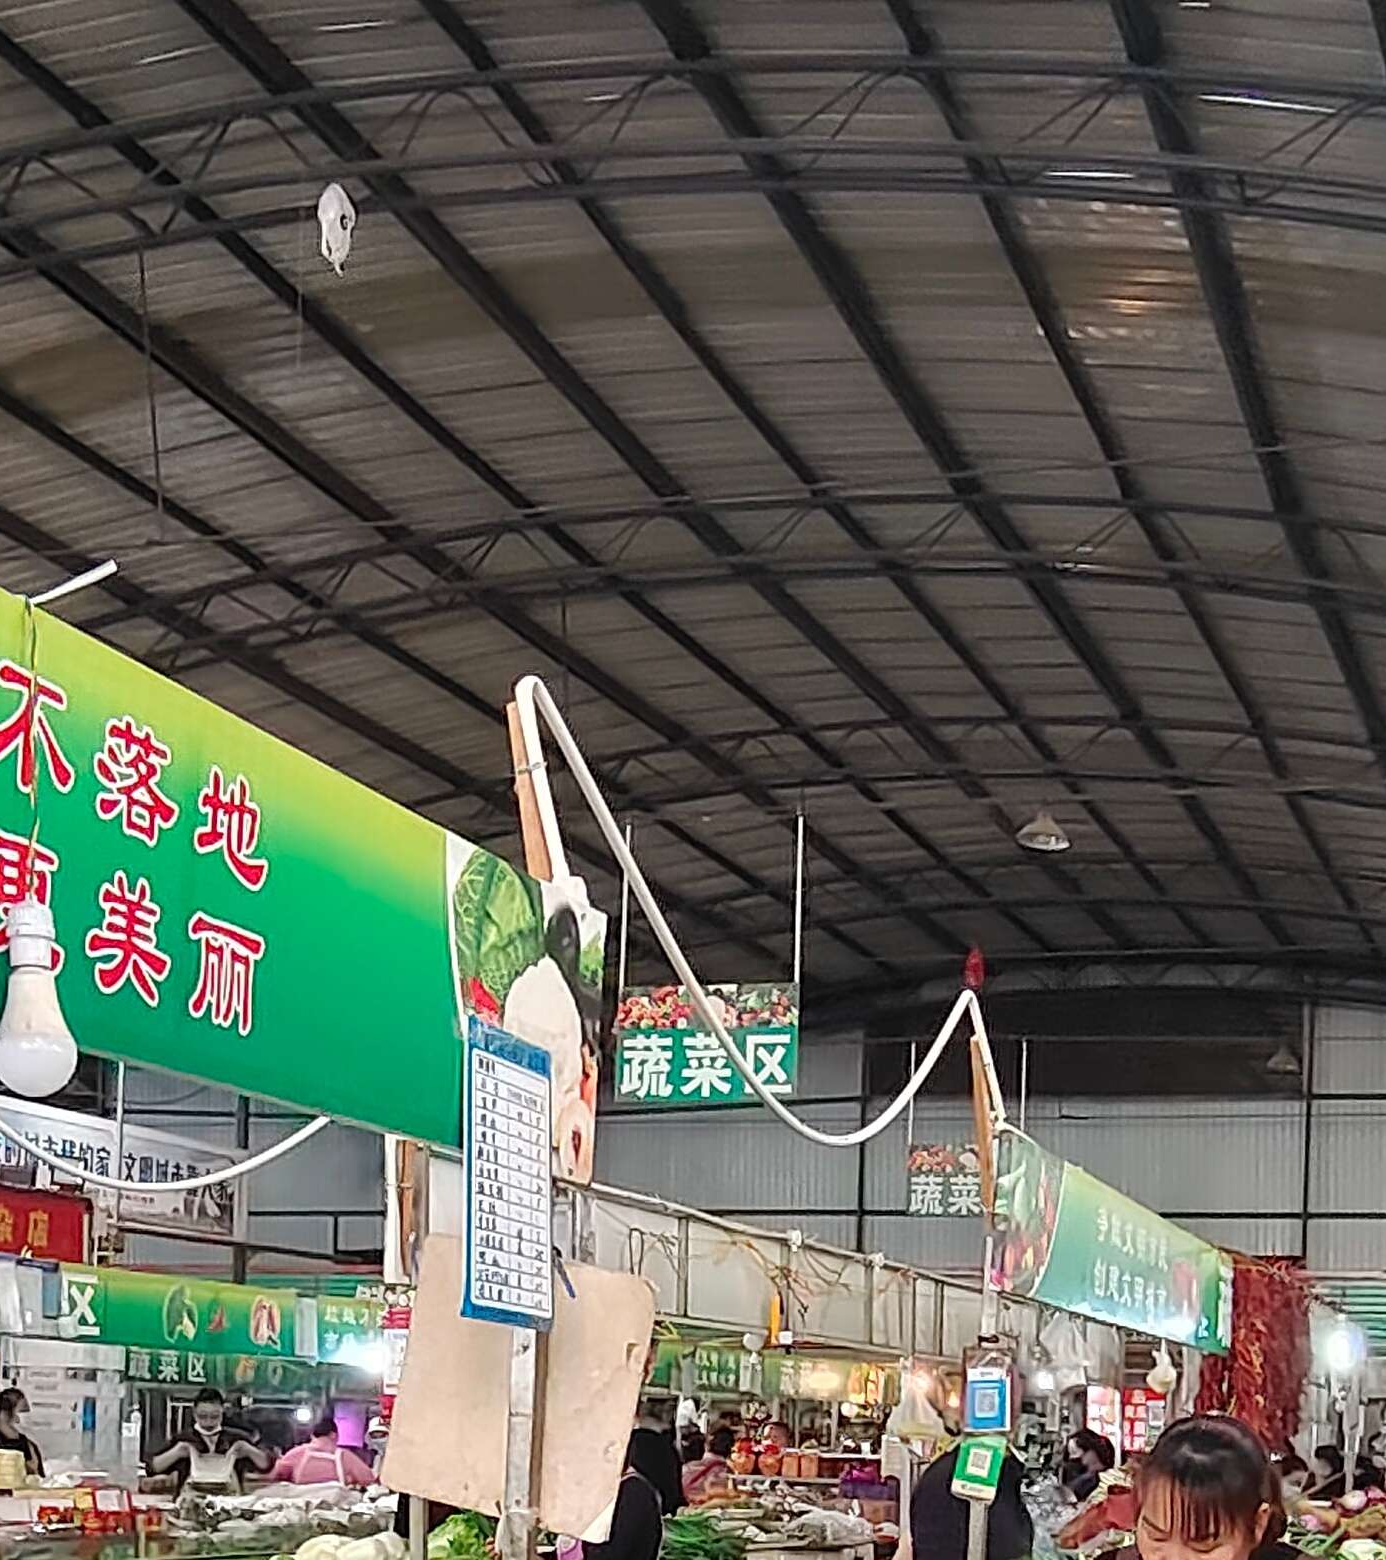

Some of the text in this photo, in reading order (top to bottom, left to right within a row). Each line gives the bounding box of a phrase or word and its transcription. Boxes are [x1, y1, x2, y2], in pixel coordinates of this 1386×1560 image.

[619, 1032, 793, 1098] 蔬菜区
[908, 1174, 988, 1217] 蔬菜
[127, 1347, 207, 1383] 蔬菜区
